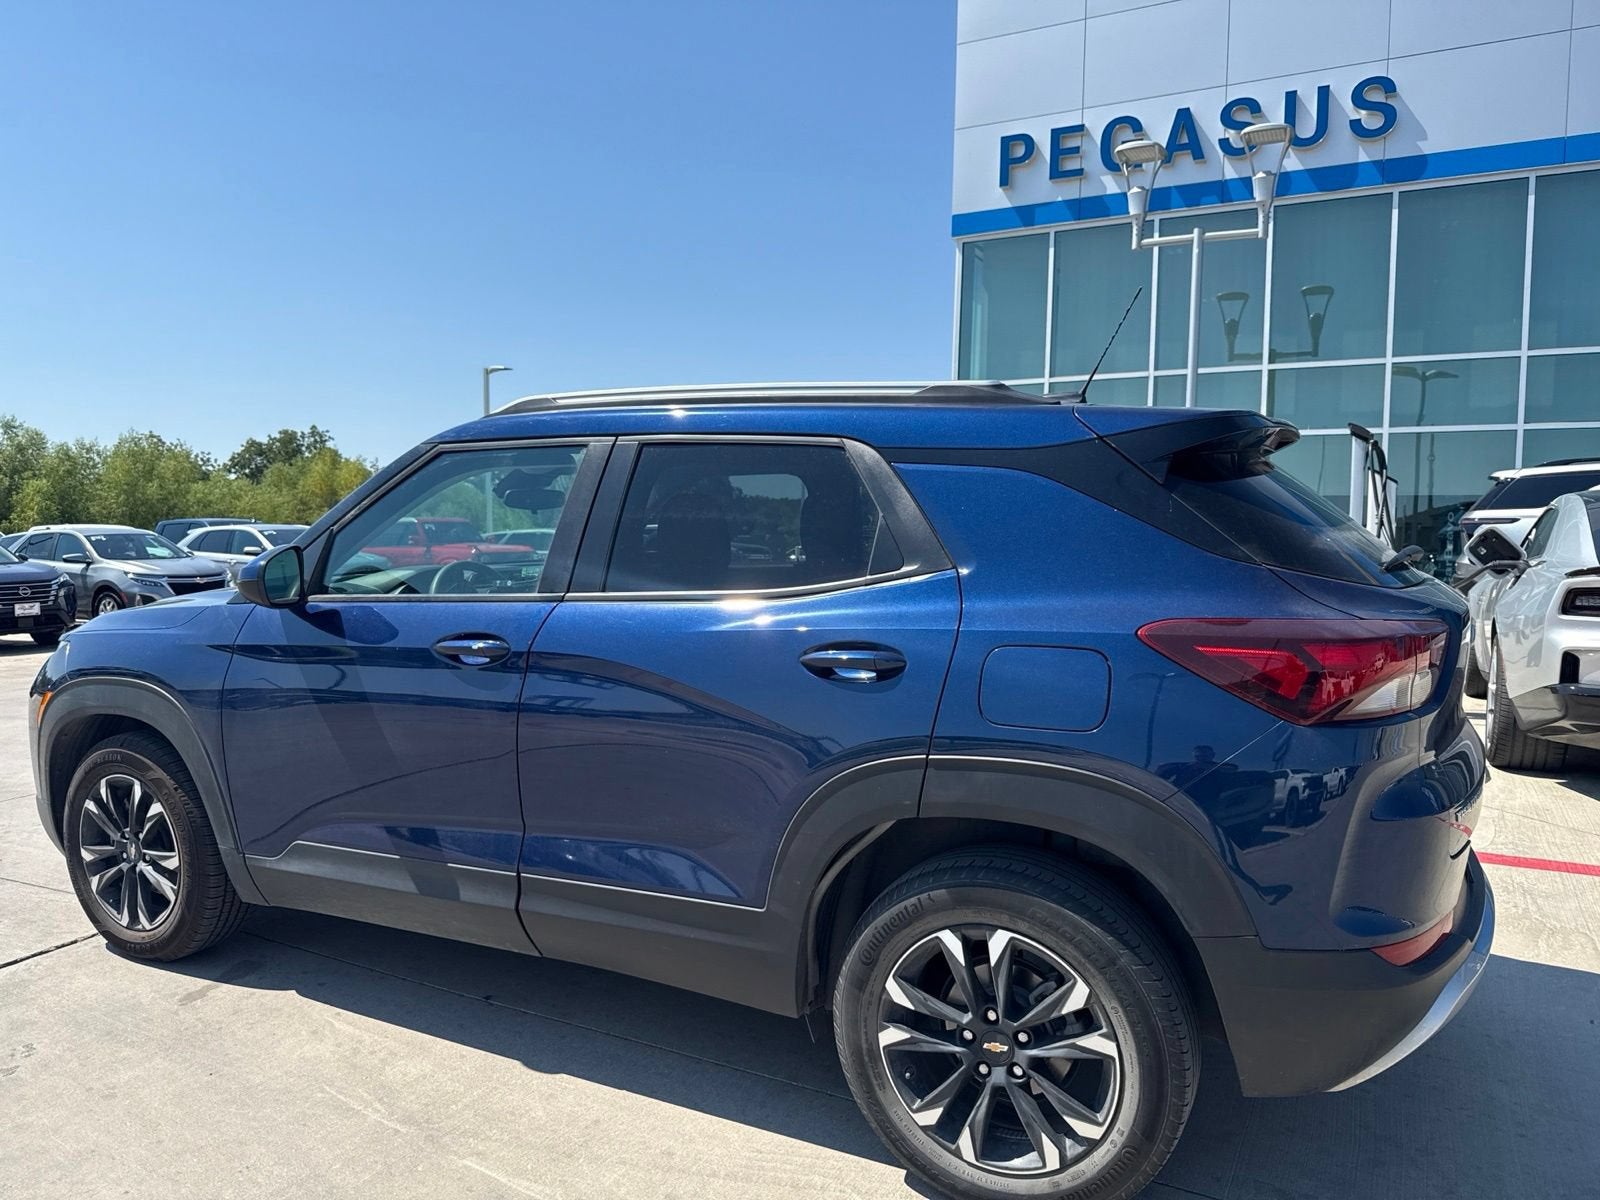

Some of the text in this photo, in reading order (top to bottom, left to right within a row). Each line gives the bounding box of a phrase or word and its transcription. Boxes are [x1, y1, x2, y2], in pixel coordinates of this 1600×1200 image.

[999, 75, 1400, 188] PEGASUS
[860, 896, 924, 967] Continental
[1061, 1145, 1137, 1200] Continenta
